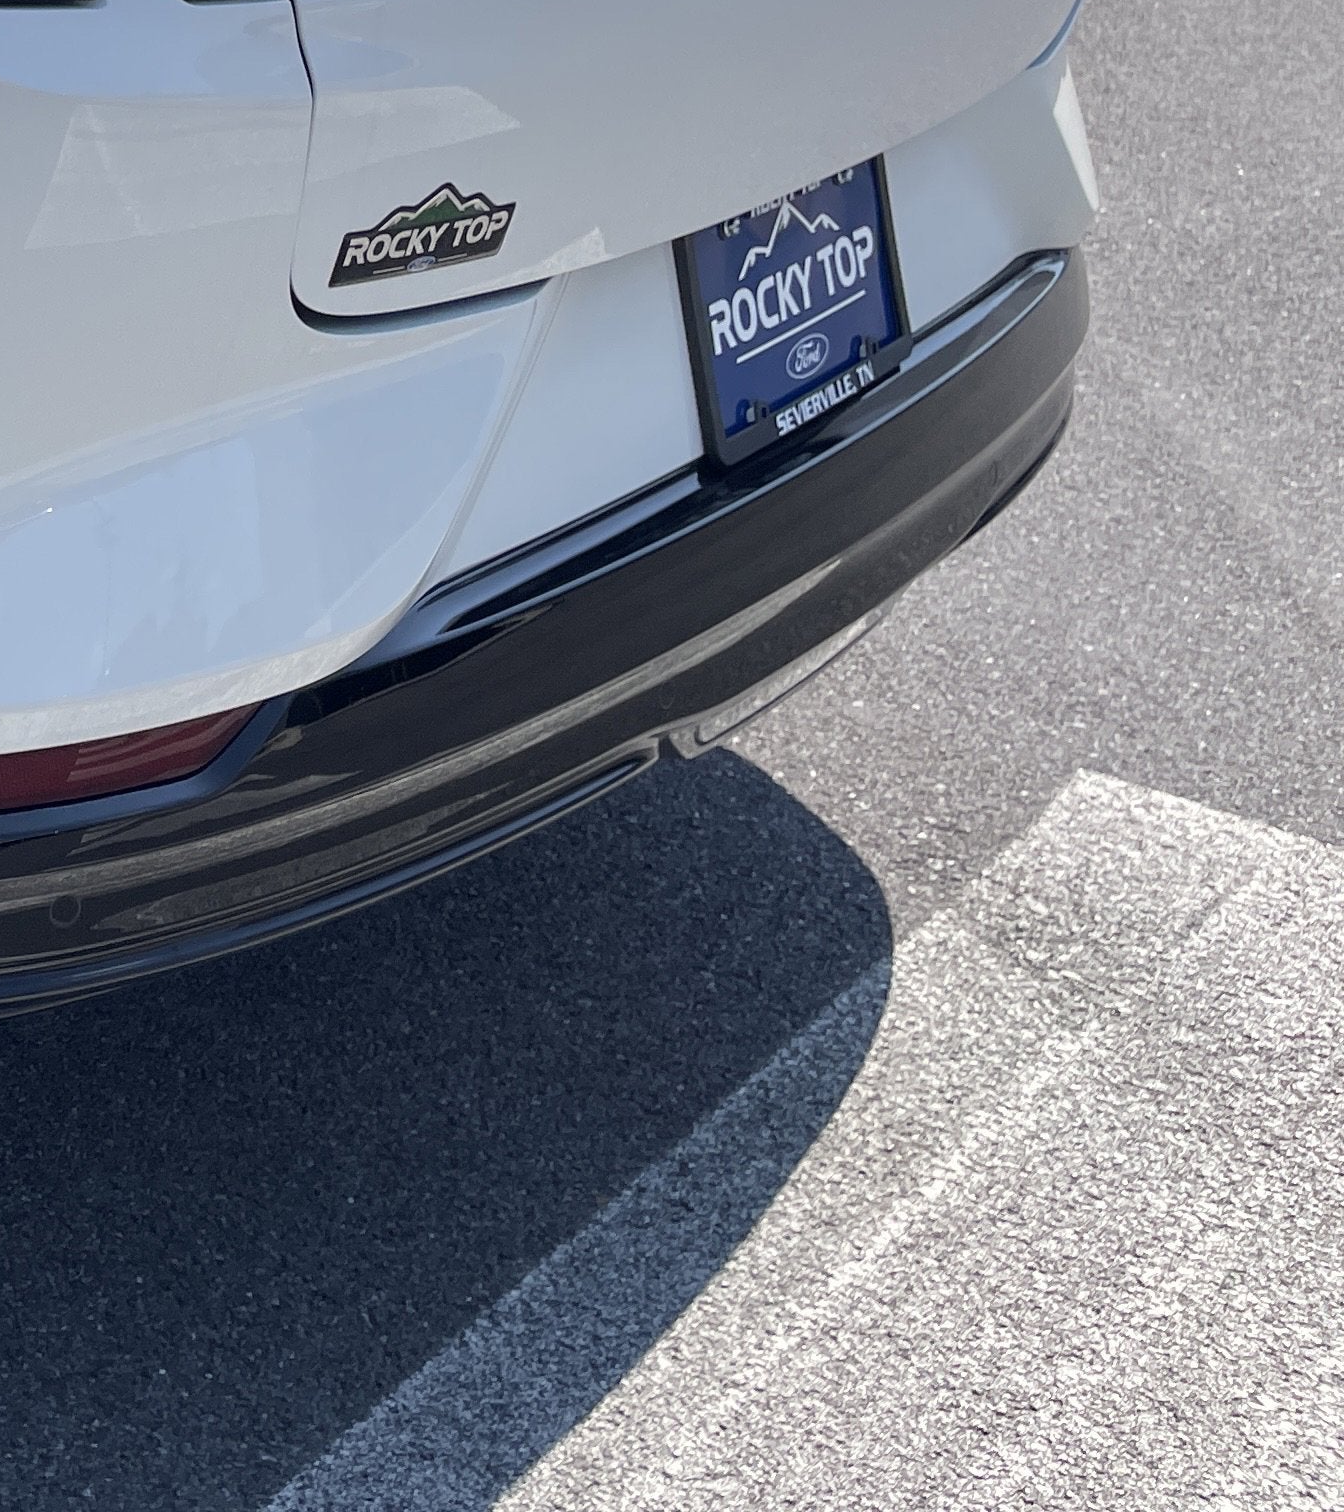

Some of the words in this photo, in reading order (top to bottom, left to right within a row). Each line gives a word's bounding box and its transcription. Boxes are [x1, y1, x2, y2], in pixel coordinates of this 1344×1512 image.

[343, 222, 450, 267] ROCKY
[452, 210, 509, 248] TOP
[709, 255, 812, 356] ROCKY
[816, 225, 873, 296] TOP
[776, 373, 857, 436] SEVIERVILLE,
[856, 359, 874, 387] TN
